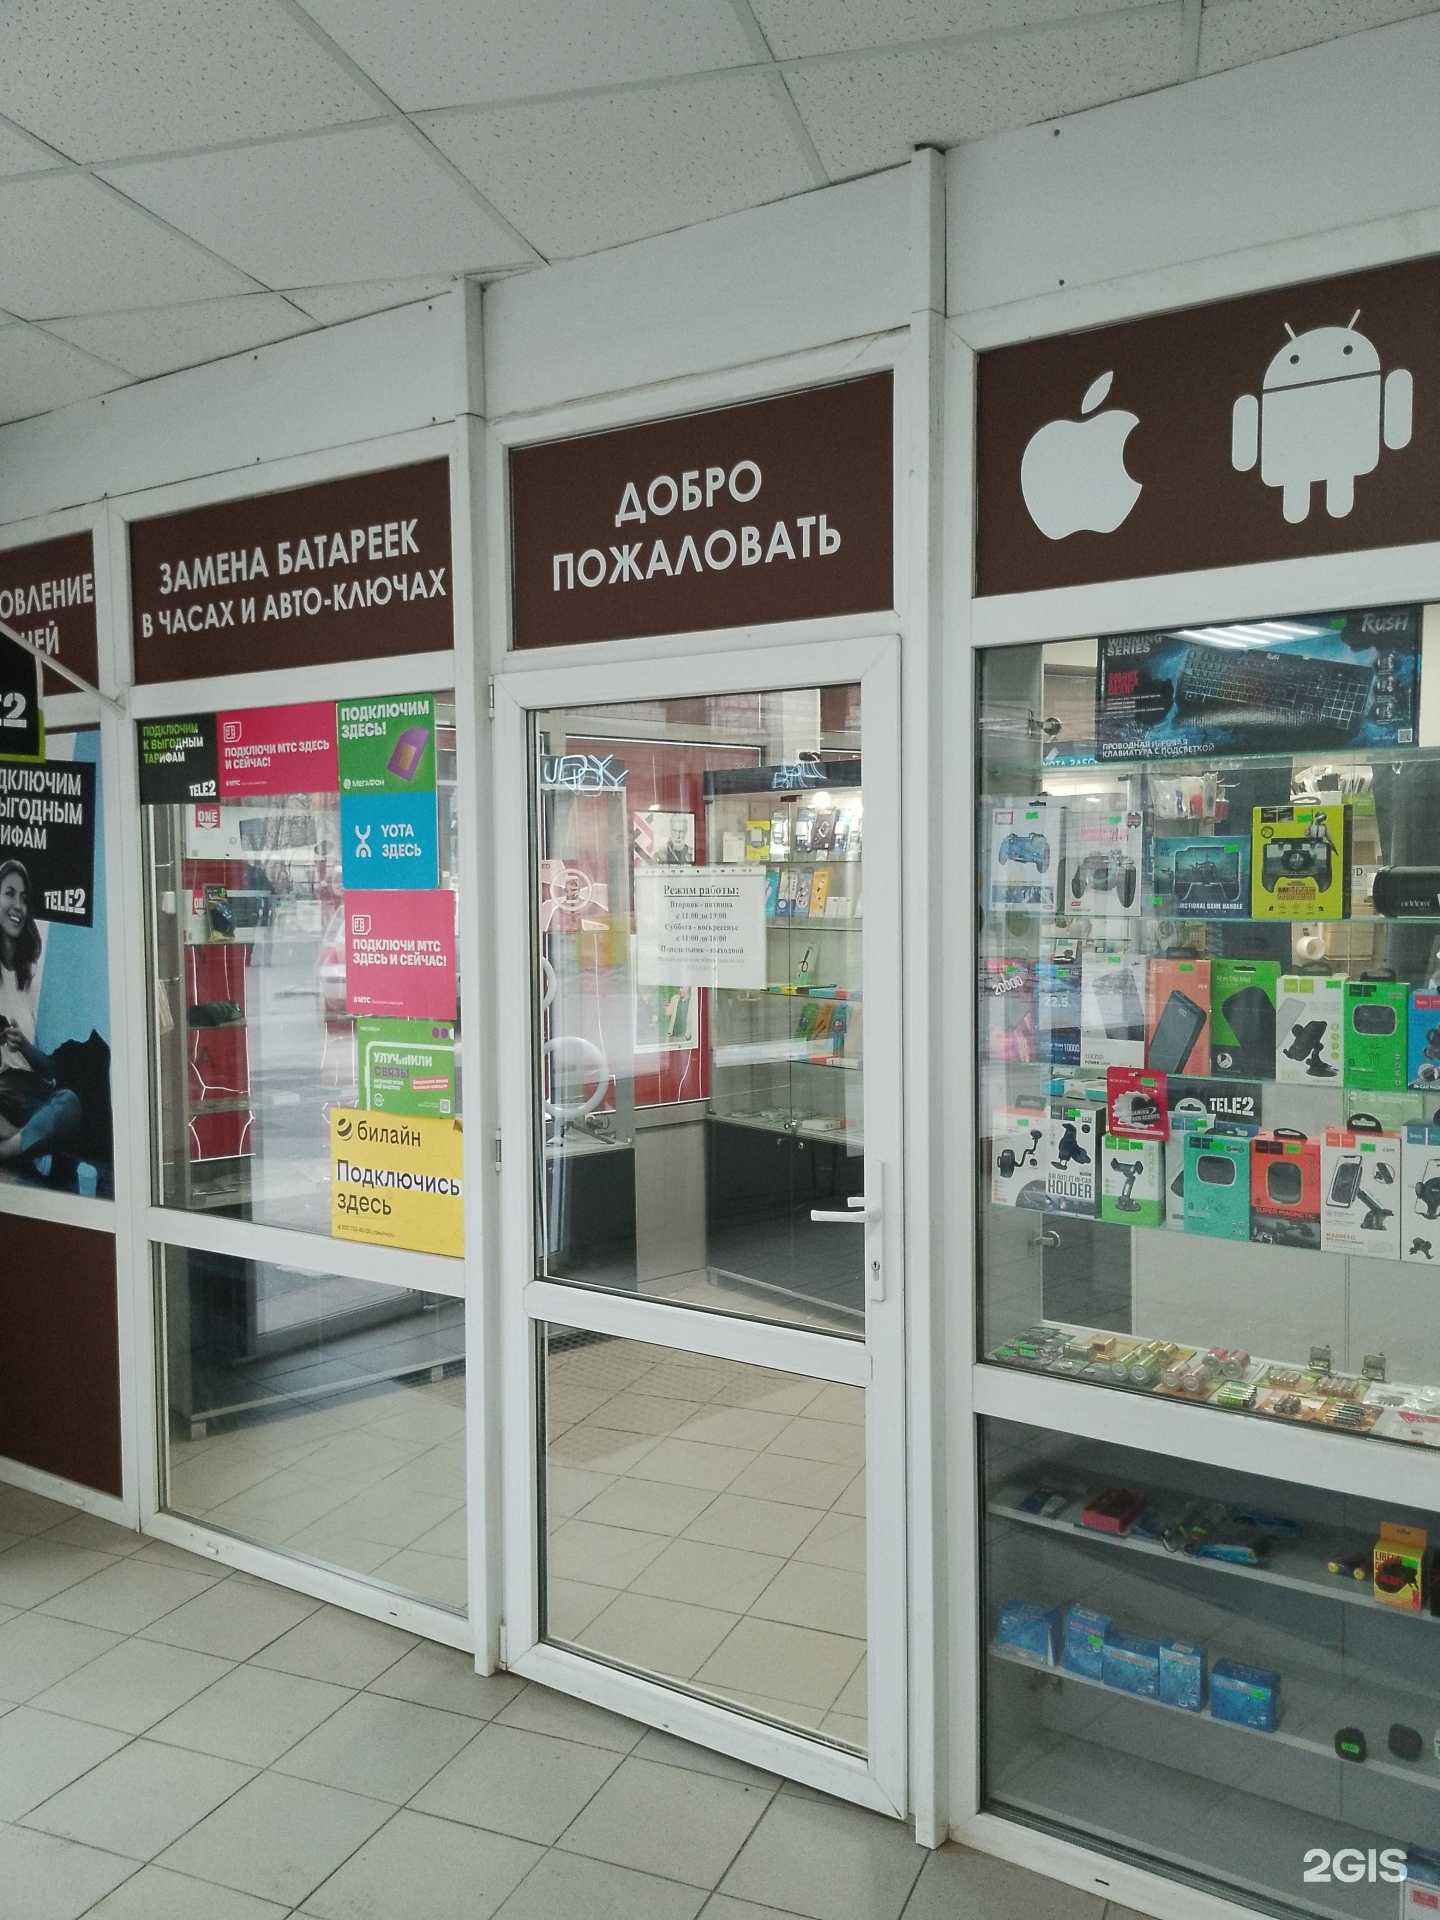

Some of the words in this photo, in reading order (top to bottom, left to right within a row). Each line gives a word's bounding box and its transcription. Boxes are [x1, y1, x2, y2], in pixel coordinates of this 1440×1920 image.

[614, 460, 762, 527] ДОБРО
[159, 546, 269, 595] ЗАМЕНА
[278, 518, 419, 576] БАТАРЕЕК
[552, 514, 842, 592] ПОЖАЛОВАТЬ
[142, 613, 154, 639] В
[159, 600, 234, 636] ЧАСАХ
[241, 597, 256, 625] И
[263, 567, 447, 622] АВТО-КЛЮЧАХ
[341, 701, 430, 721] ПОДКЛЮЧИМ
[341, 722, 387, 739] ЗДЕСЬ!
[151, 736, 204, 751] ВЫГОДНЫМ
[224, 744, 277, 758] ПОДКЛЮЧИ
[278, 742, 298, 753] МТС
[299, 740, 330, 752] ЗДЕСЬ
[144, 752, 185, 764] ТАРИФАМ
[225, 760, 232, 769] И
[233, 757, 271, 769] СЕЙЧАС!
[189, 780, 216, 796] TELE2
[381, 824, 414, 838] YOTA
[382, 844, 422, 859] ЗДЕСЬ
[664, 885, 696, 896] Режим
[699, 884, 741, 897] работы:
[44, 888, 86, 914] TELE2
[353, 939, 415, 952] ПОДКЛЮЧИ
[417, 941, 441, 952] МТС
[353, 953, 388, 966] ЗДЕСЬ
[390, 954, 397, 965] И
[400, 952, 447, 966] СЕЙЧАС!
[1209, 1096, 1254, 1116] TELE2
[357, 1120, 421, 1147] билайн
[337, 1159, 460, 1196] Подключись
[1047, 1180, 1092, 1199] HOLDER
[337, 1193, 392, 1216] здесь
